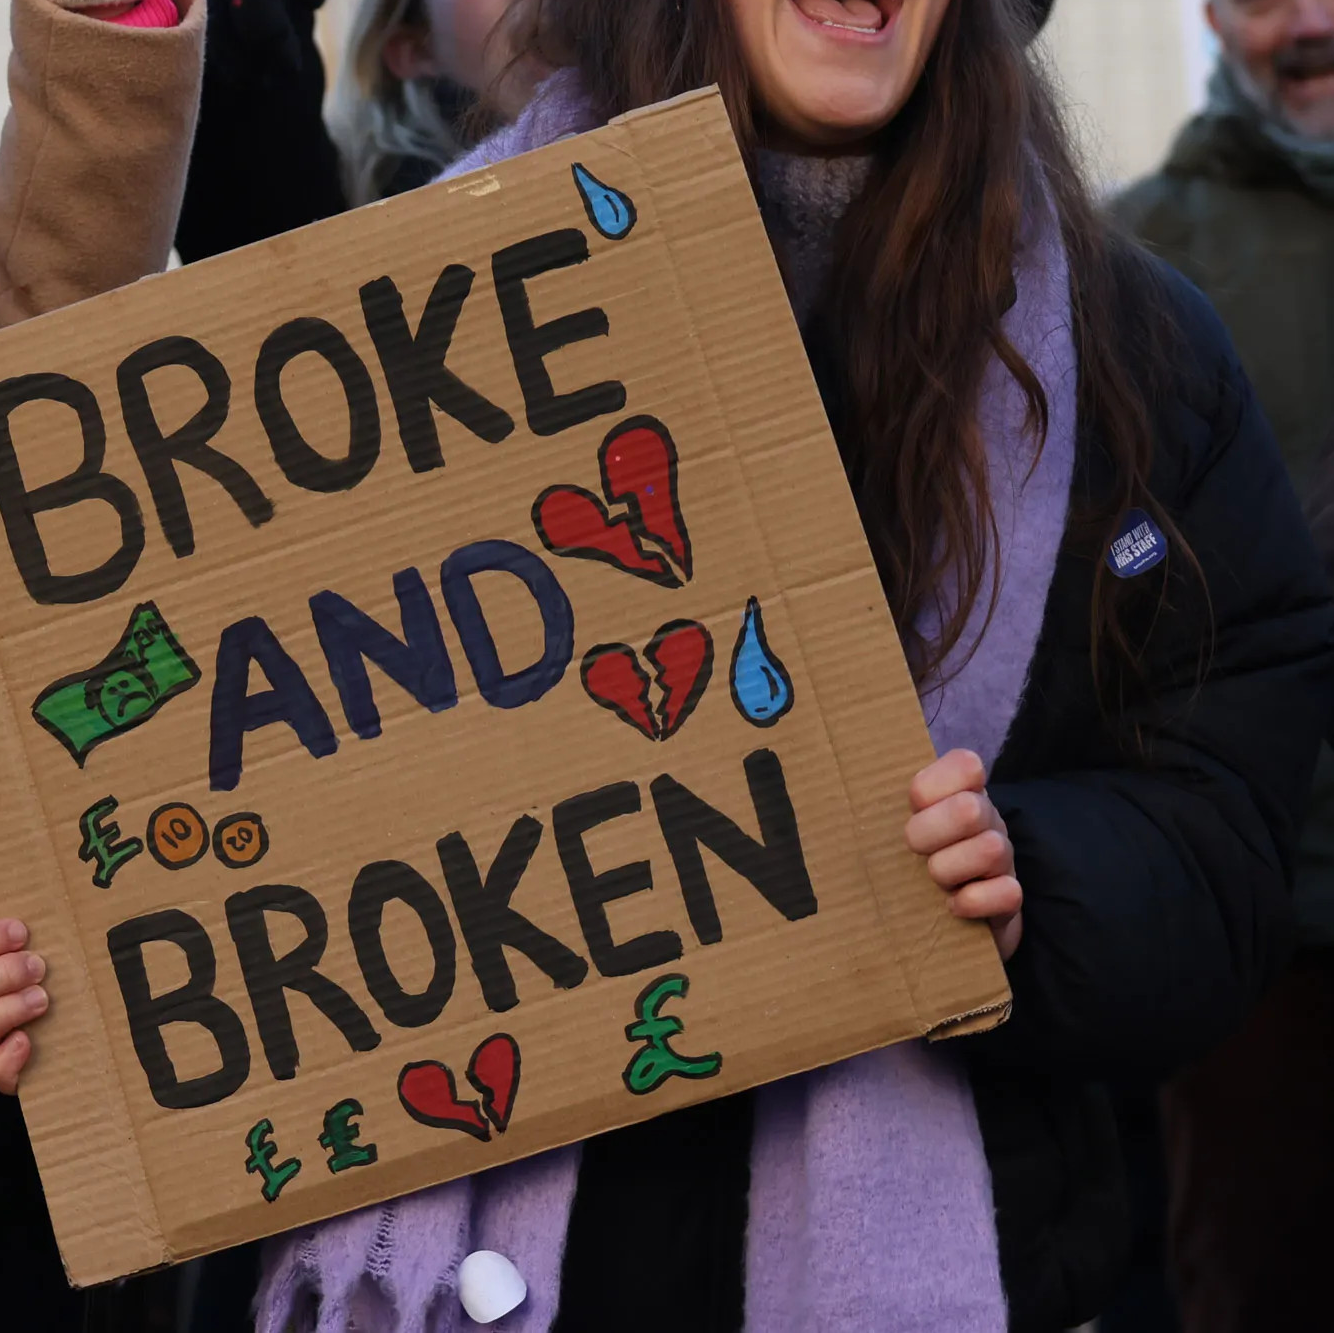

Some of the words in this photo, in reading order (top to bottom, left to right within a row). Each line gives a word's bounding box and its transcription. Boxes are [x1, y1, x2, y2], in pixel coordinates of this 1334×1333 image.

[1110, 545, 1116, 556] I
[1113, 532, 1134, 554] STAND
[1131, 521, 1151, 541] WITH
[1114, 548, 1135, 569] NHS
[1130, 532, 1157, 557] STAFF
[208, 538, 575, 792] AND
[161, 817, 192, 850] 10
[226, 826, 253, 852] 20
[106, 748, 818, 1111] BROKEN
[620, 972, 723, 1097] £
[244, 1118, 303, 1204] £
[318, 1097, 379, 1175] £
